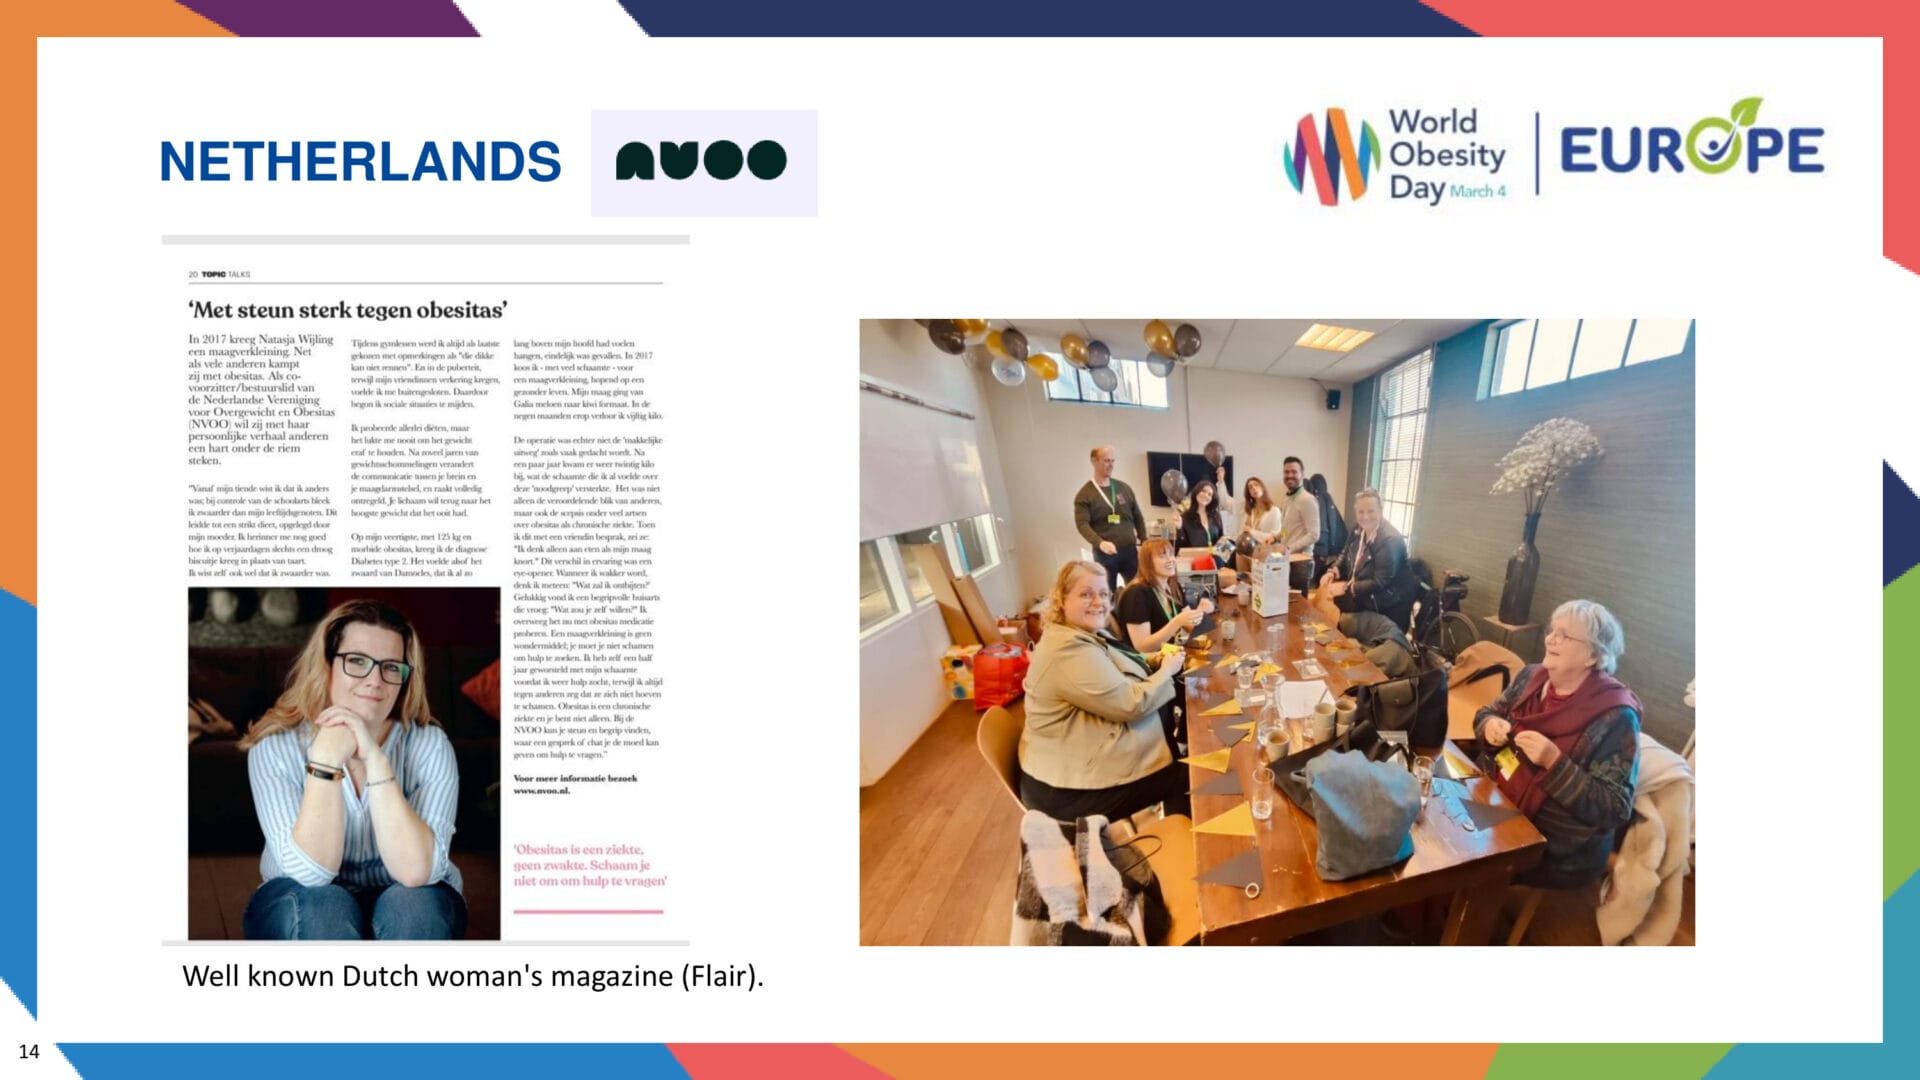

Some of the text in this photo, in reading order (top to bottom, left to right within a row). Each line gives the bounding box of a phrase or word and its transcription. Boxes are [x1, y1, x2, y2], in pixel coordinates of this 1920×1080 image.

[238, 304, 294, 318] steun
[299, 301, 352, 318] sterk
[356, 304, 412, 321] tegen
[417, 300, 507, 318] obesitas’
[189, 334, 199, 344] In
[202, 334, 226, 344] 2017
[230, 334, 256, 348] kreeg
[259, 334, 295, 348] Natasja
[294, 346, 311, 356] Net
[189, 358, 299, 372] als vele anderen kampt
[189, 370, 200, 384] zij
[203, 370, 221, 380] met
[224, 370, 264, 380] obesitas.
[268, 370, 283, 380] Als
[189, 382, 294, 392] voorzitter/bestuurslid
[188, 394, 320, 408] de Nederlandse Vereniging
[213, 406, 275, 420] Overgewicht
[293, 406, 335, 416] Obesitas
[189, 419, 310, 432] (NVOO) wil zij met haar
[189, 431, 328, 444] persoonlijke verhaal anderen
[209, 443, 228, 453] hart
[232, 443, 260, 453] onder
[263, 443, 274, 453] de
[278, 443, 300, 453] riem
[188, 455, 221, 465] steken.
[514, 774, 534, 783] Voor
[560, 774, 606, 783] informatie
[608, 774, 637, 783] bezoek
[570, 844, 581, 855] is
[606, 844, 644, 855] ziekte,
[514, 860, 650, 872] geen zwakte. Schaam je
[514, 876, 536, 886] niet
[582, 875, 610, 888] hulp
[611, 878, 623, 886] te
